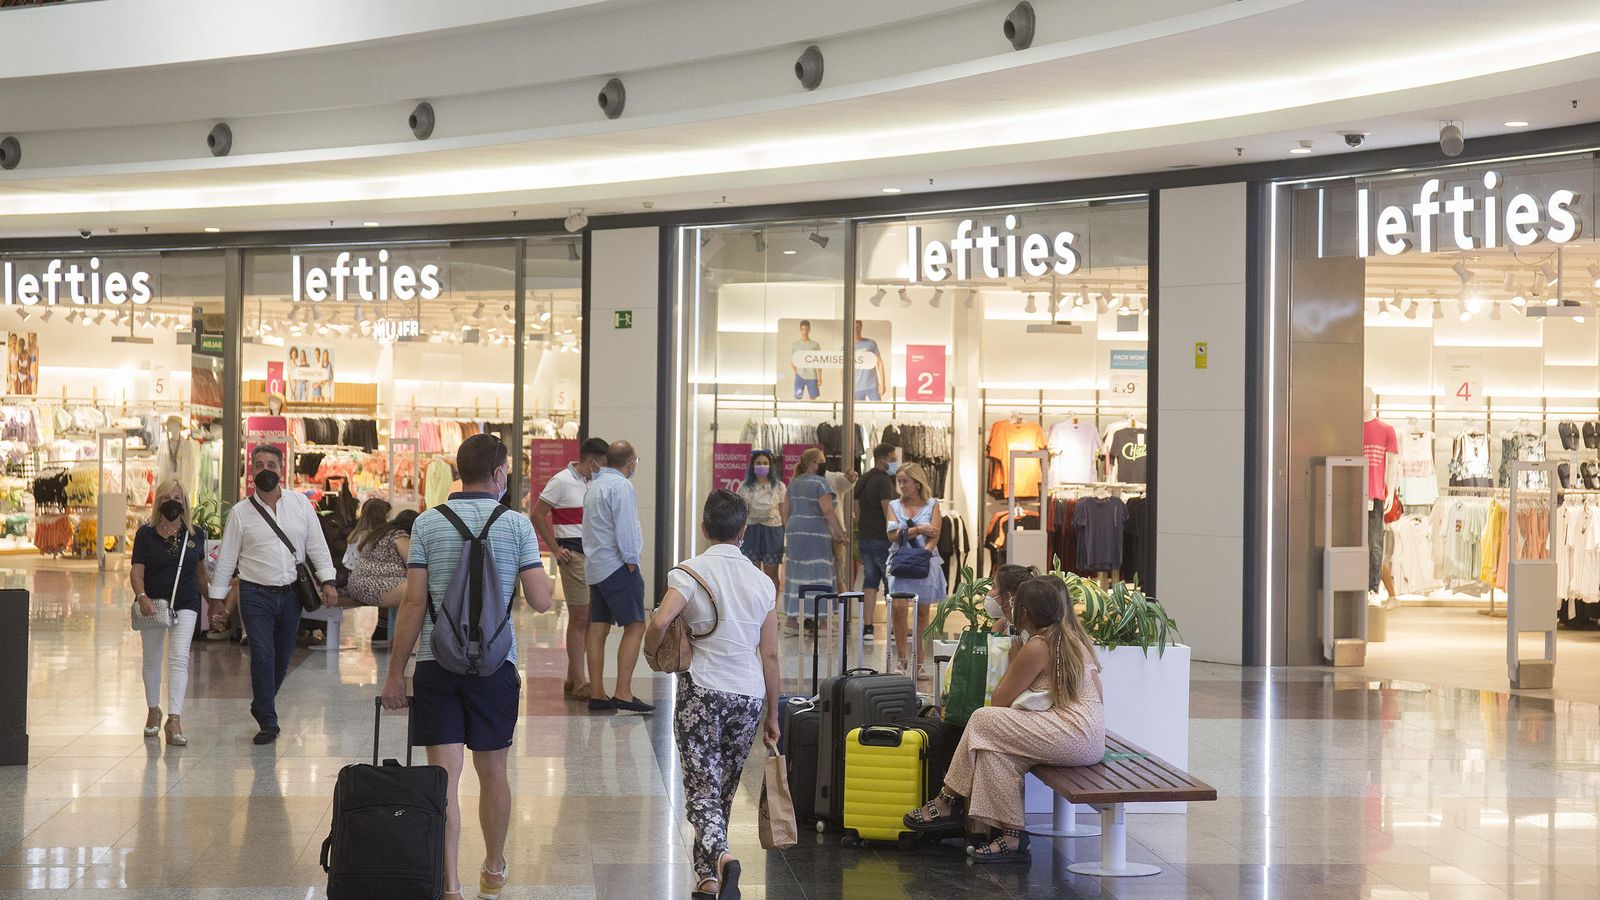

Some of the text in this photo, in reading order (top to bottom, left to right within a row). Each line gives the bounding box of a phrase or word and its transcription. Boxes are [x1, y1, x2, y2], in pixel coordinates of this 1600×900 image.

[1358, 171, 1577, 258] lefties
[908, 214, 1078, 283] lefties
[4, 257, 151, 305] lefties
[292, 249, 440, 302] lefties
[155, 378, 164, 394] 5
[917, 372, 934, 395] 2
[1456, 382, 1472, 401] 4
